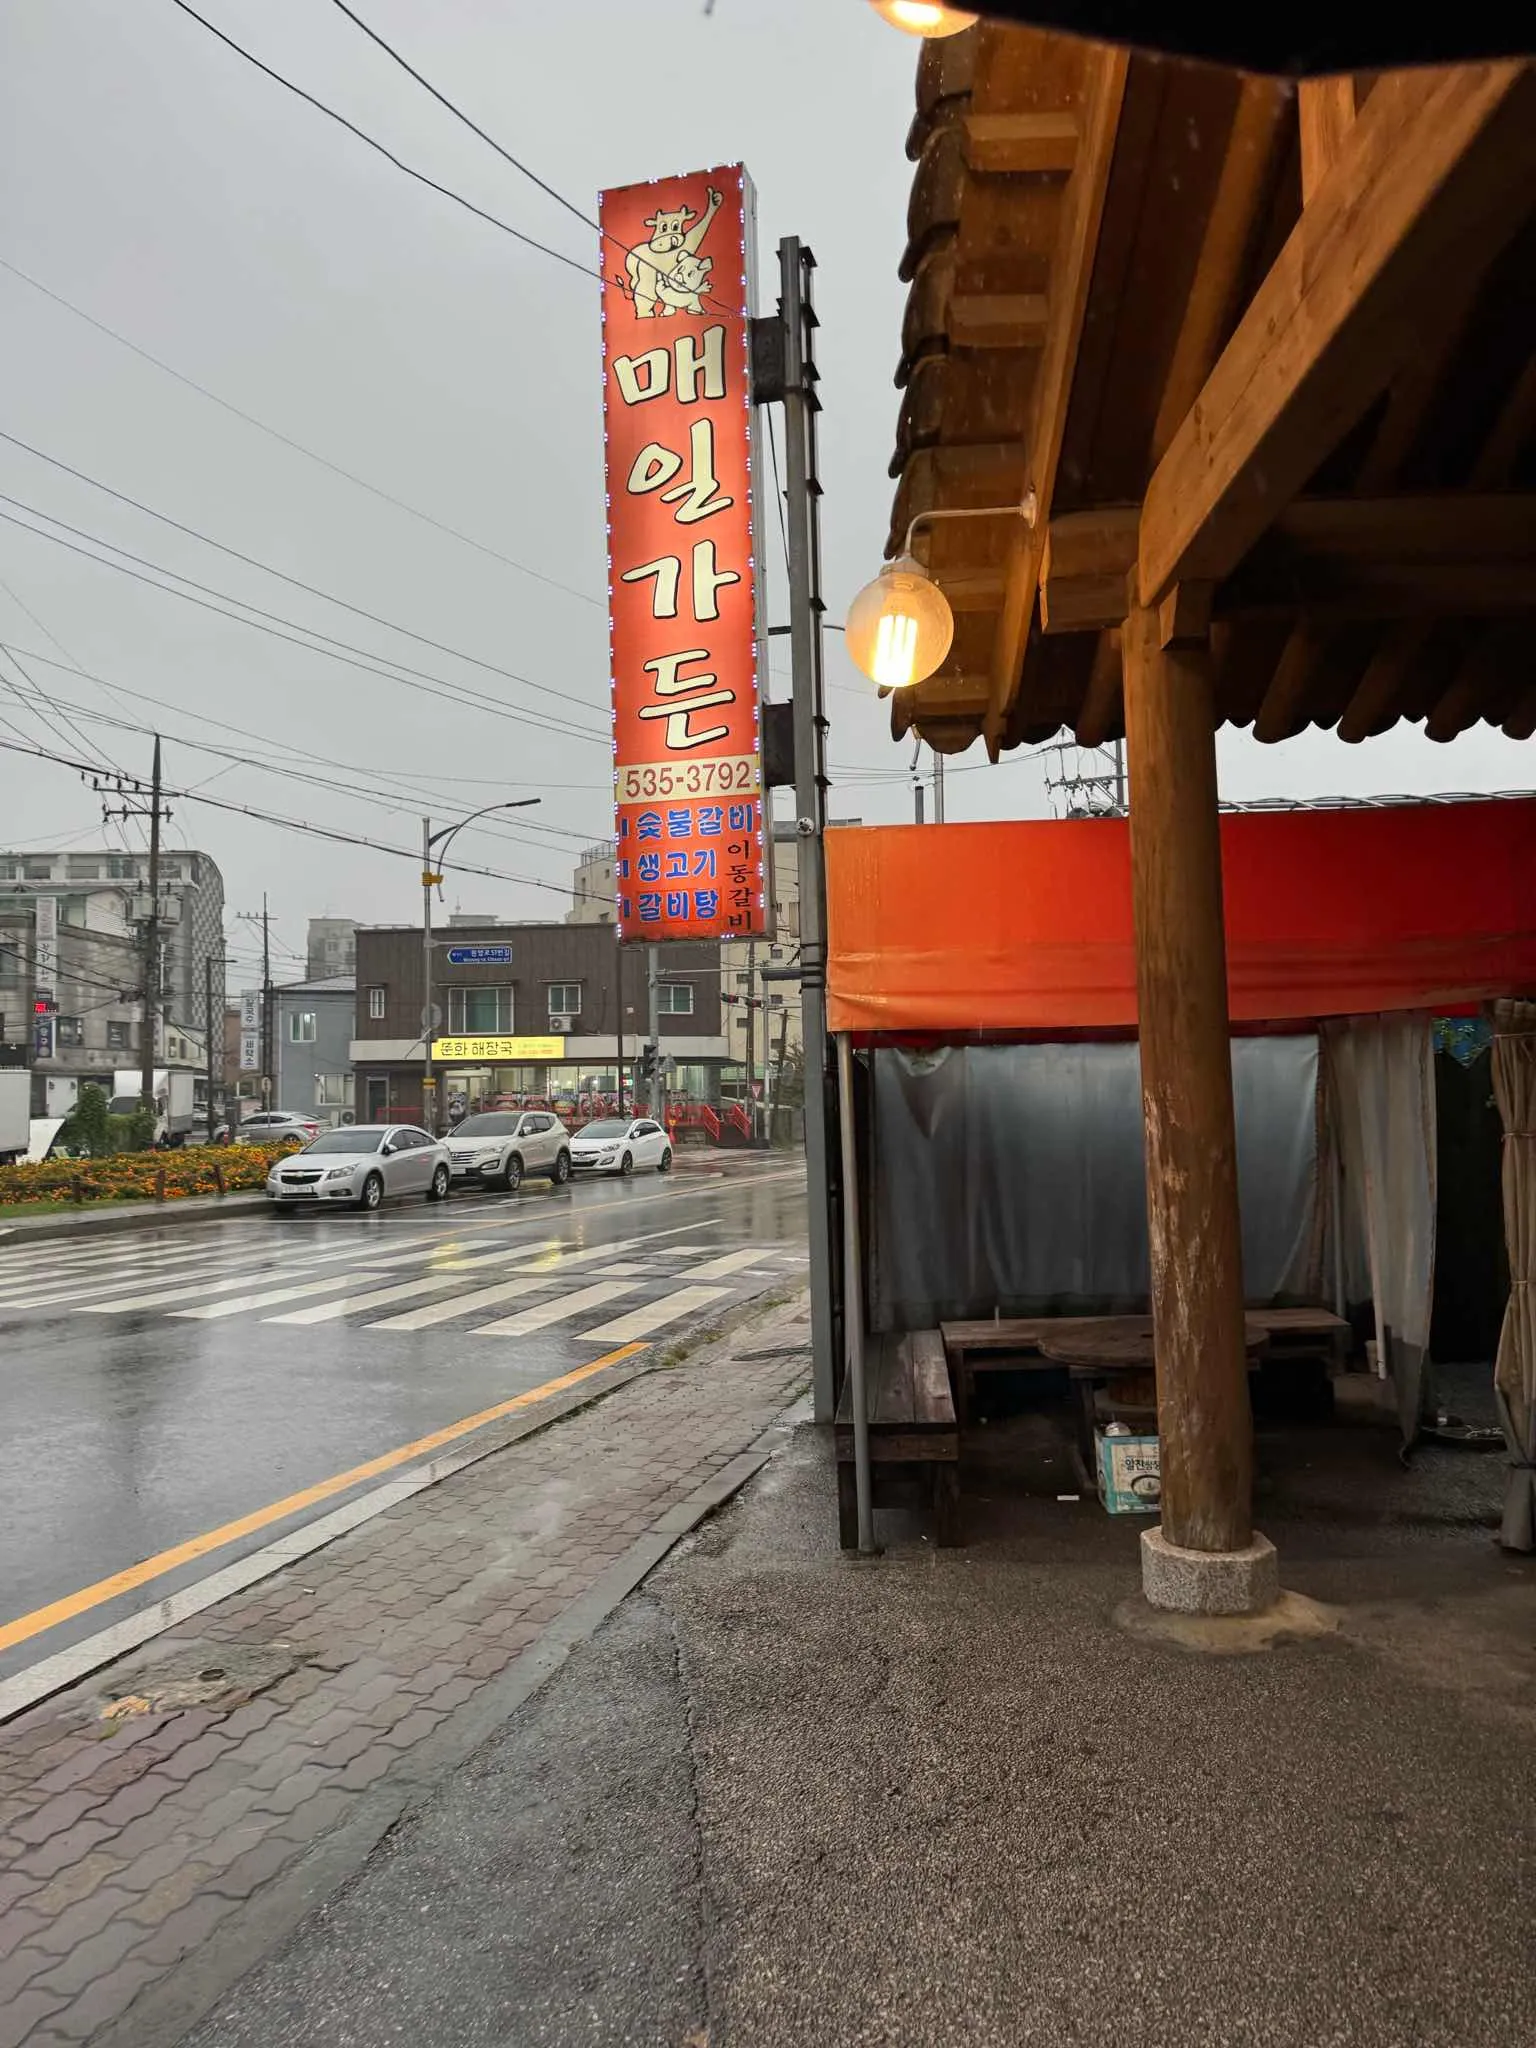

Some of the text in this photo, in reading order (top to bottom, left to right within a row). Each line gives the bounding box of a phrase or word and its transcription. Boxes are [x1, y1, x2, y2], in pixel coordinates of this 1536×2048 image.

[612, 324, 742, 750] 매일가든
[625, 761, 751, 798] 535-3792
[636, 804, 754, 841] 숯불갈비
[636, 848, 718, 883] 생고기
[725, 840, 754, 930] 이동갈비
[637, 889, 720, 922] 갈비탕
[471, 1041, 513, 1056] 해장국
